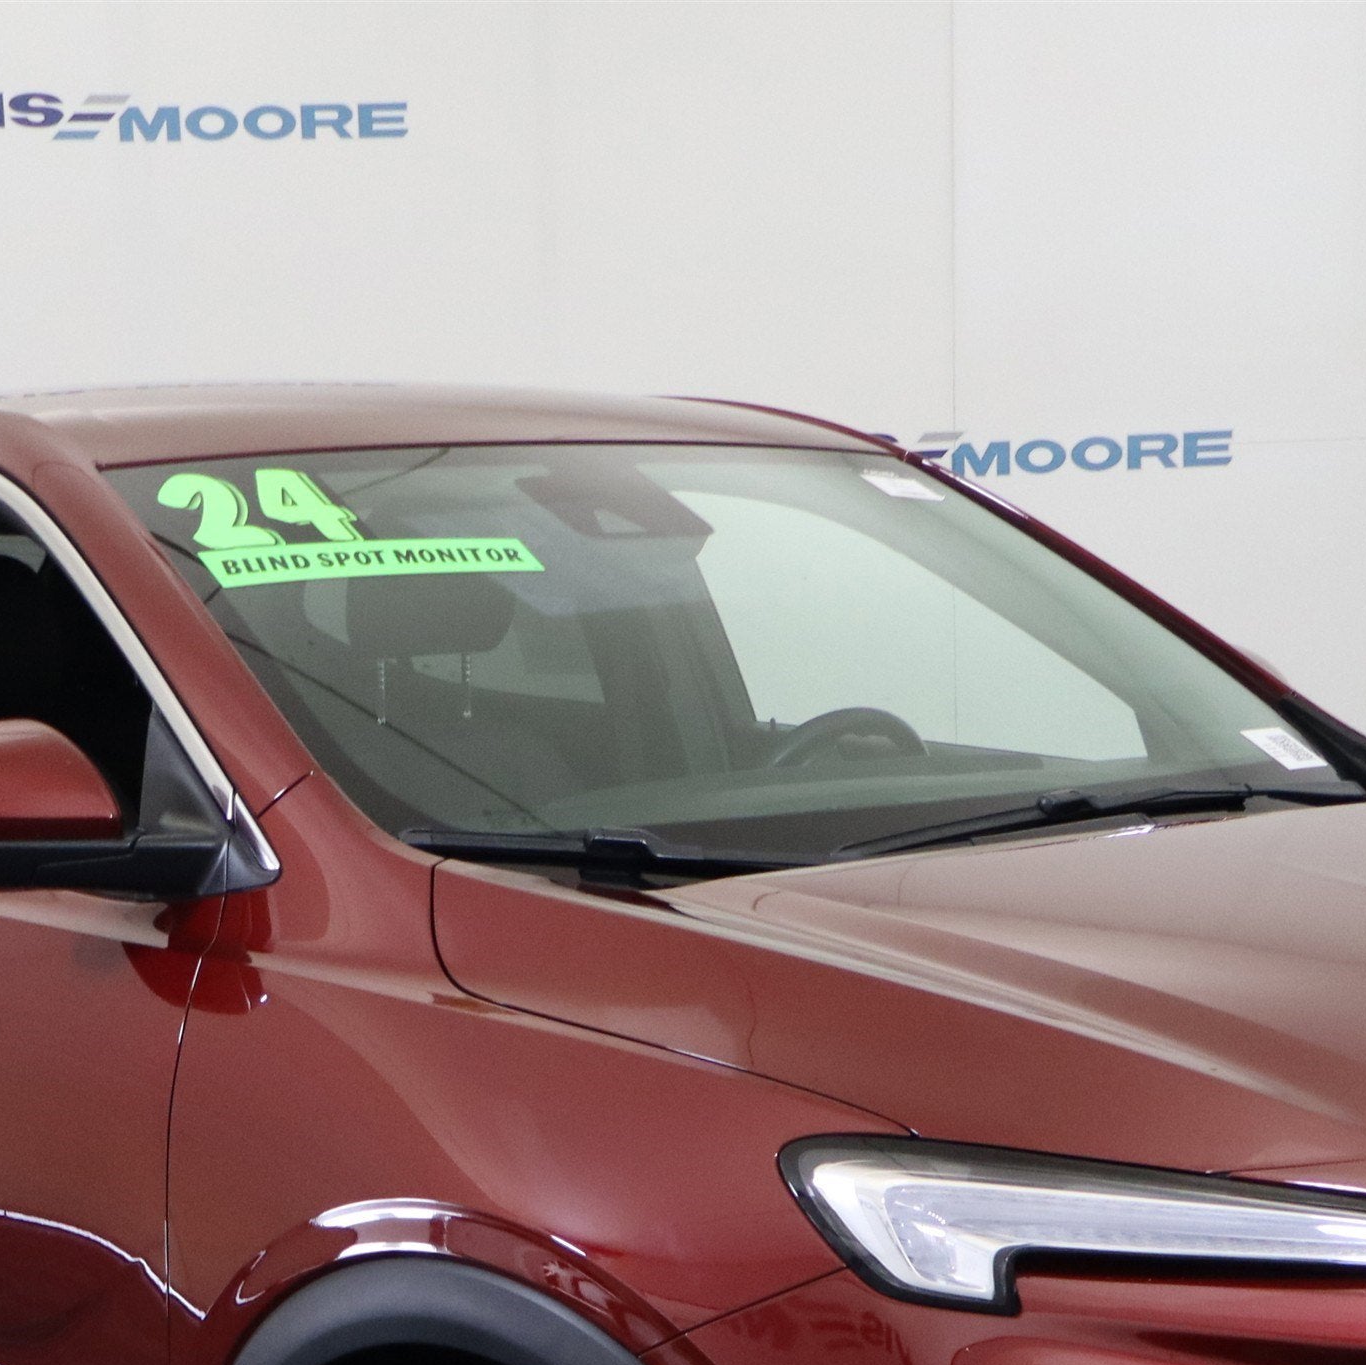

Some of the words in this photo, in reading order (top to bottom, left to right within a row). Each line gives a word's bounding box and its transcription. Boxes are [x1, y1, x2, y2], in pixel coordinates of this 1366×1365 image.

[117, 101, 408, 142] MOORE
[951, 429, 1233, 477] MOORE
[157, 468, 364, 550] 24
[221, 553, 311, 576] BLIND
[317, 550, 387, 567] SPOT
[394, 547, 525, 565] MONITOR
